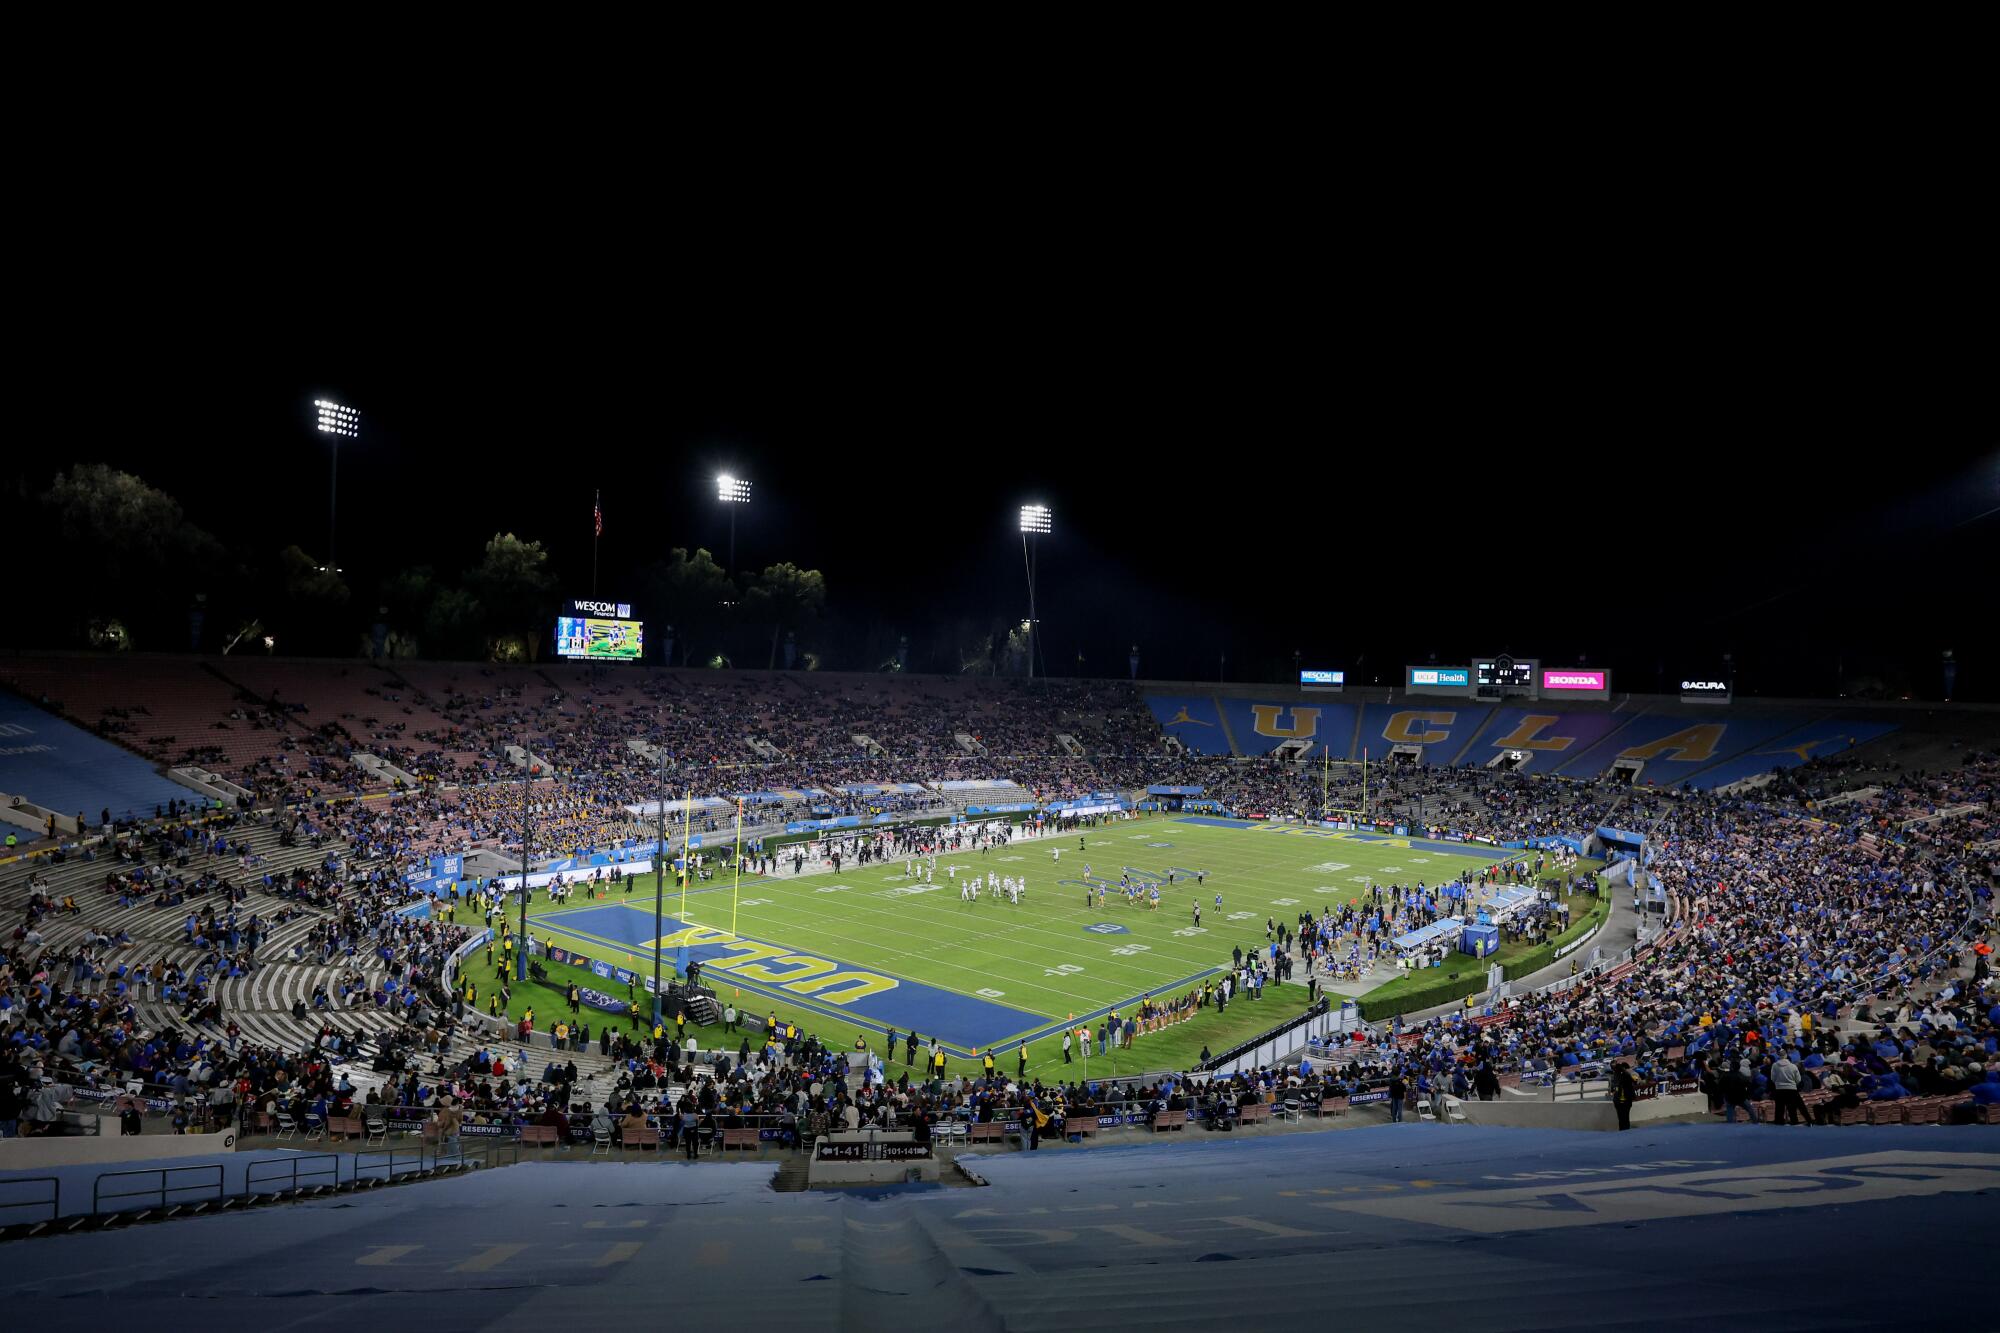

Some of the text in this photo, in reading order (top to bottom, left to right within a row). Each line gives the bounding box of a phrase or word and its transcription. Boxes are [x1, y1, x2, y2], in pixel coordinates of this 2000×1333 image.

[575, 600, 616, 613] WESCOM
[1439, 671, 1466, 683] Health
[1549, 676, 1599, 686] HONDA
[1690, 681, 1727, 690] ACURA
[1511, 751, 1522, 760] 25
[444, 858, 458, 866] SEAT
[1112, 944, 1151, 956] 20
[638, 927, 900, 1005] UCLA
[1044, 964, 1085, 976] 10
[1351, 1091, 1382, 1104] RESERVED
[1159, 1099, 1168, 1111] 3
[388, 1121, 423, 1134] ESERVED
[461, 1125, 501, 1134] RESERVED
[833, 1145, 860, 1157] 1-41
[887, 1147, 918, 1156] 101-141
